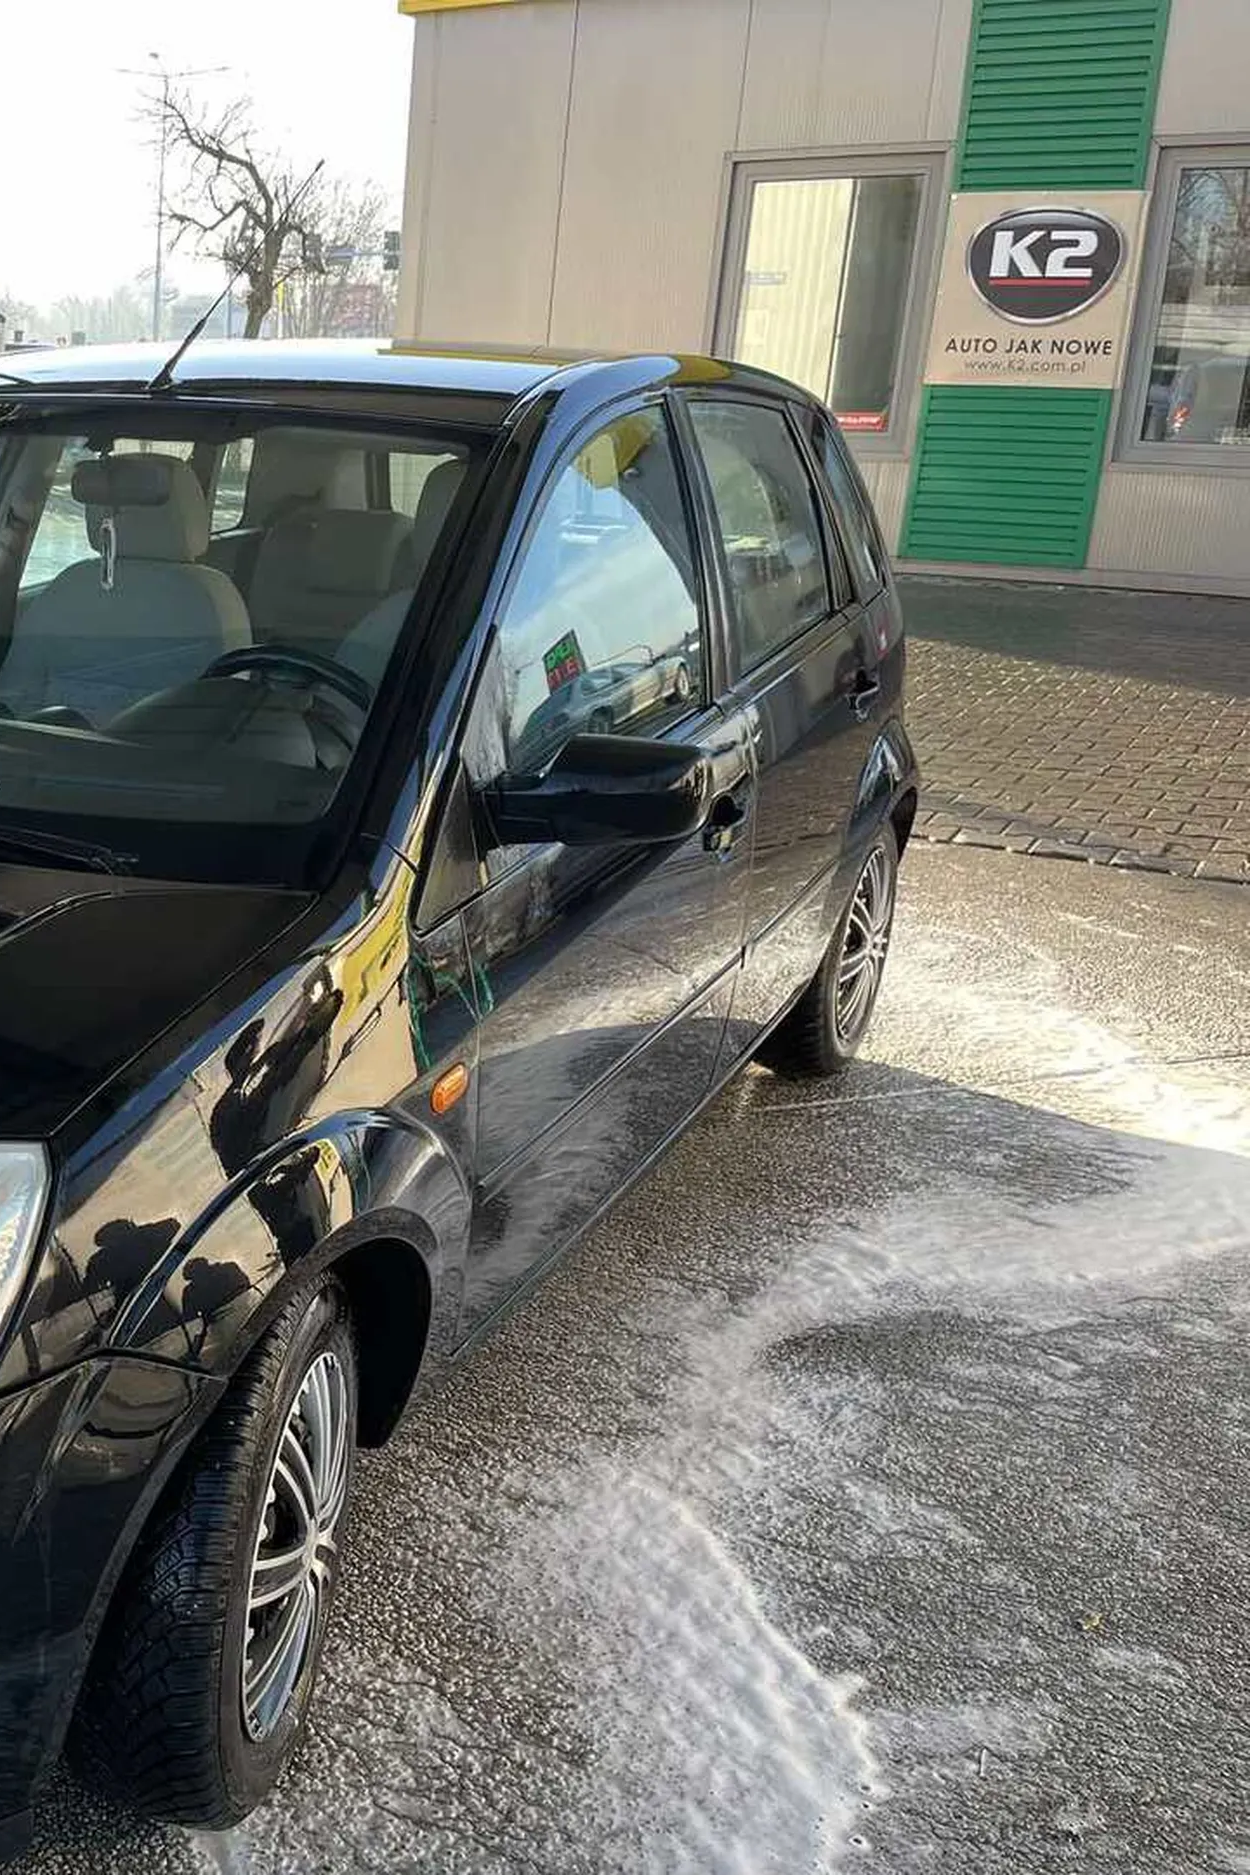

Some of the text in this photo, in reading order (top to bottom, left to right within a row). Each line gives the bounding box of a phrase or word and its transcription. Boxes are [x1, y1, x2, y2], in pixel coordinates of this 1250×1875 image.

[989, 229, 1099, 279] K2
[945, 337, 1113, 356] AUTO JAK NOWE
